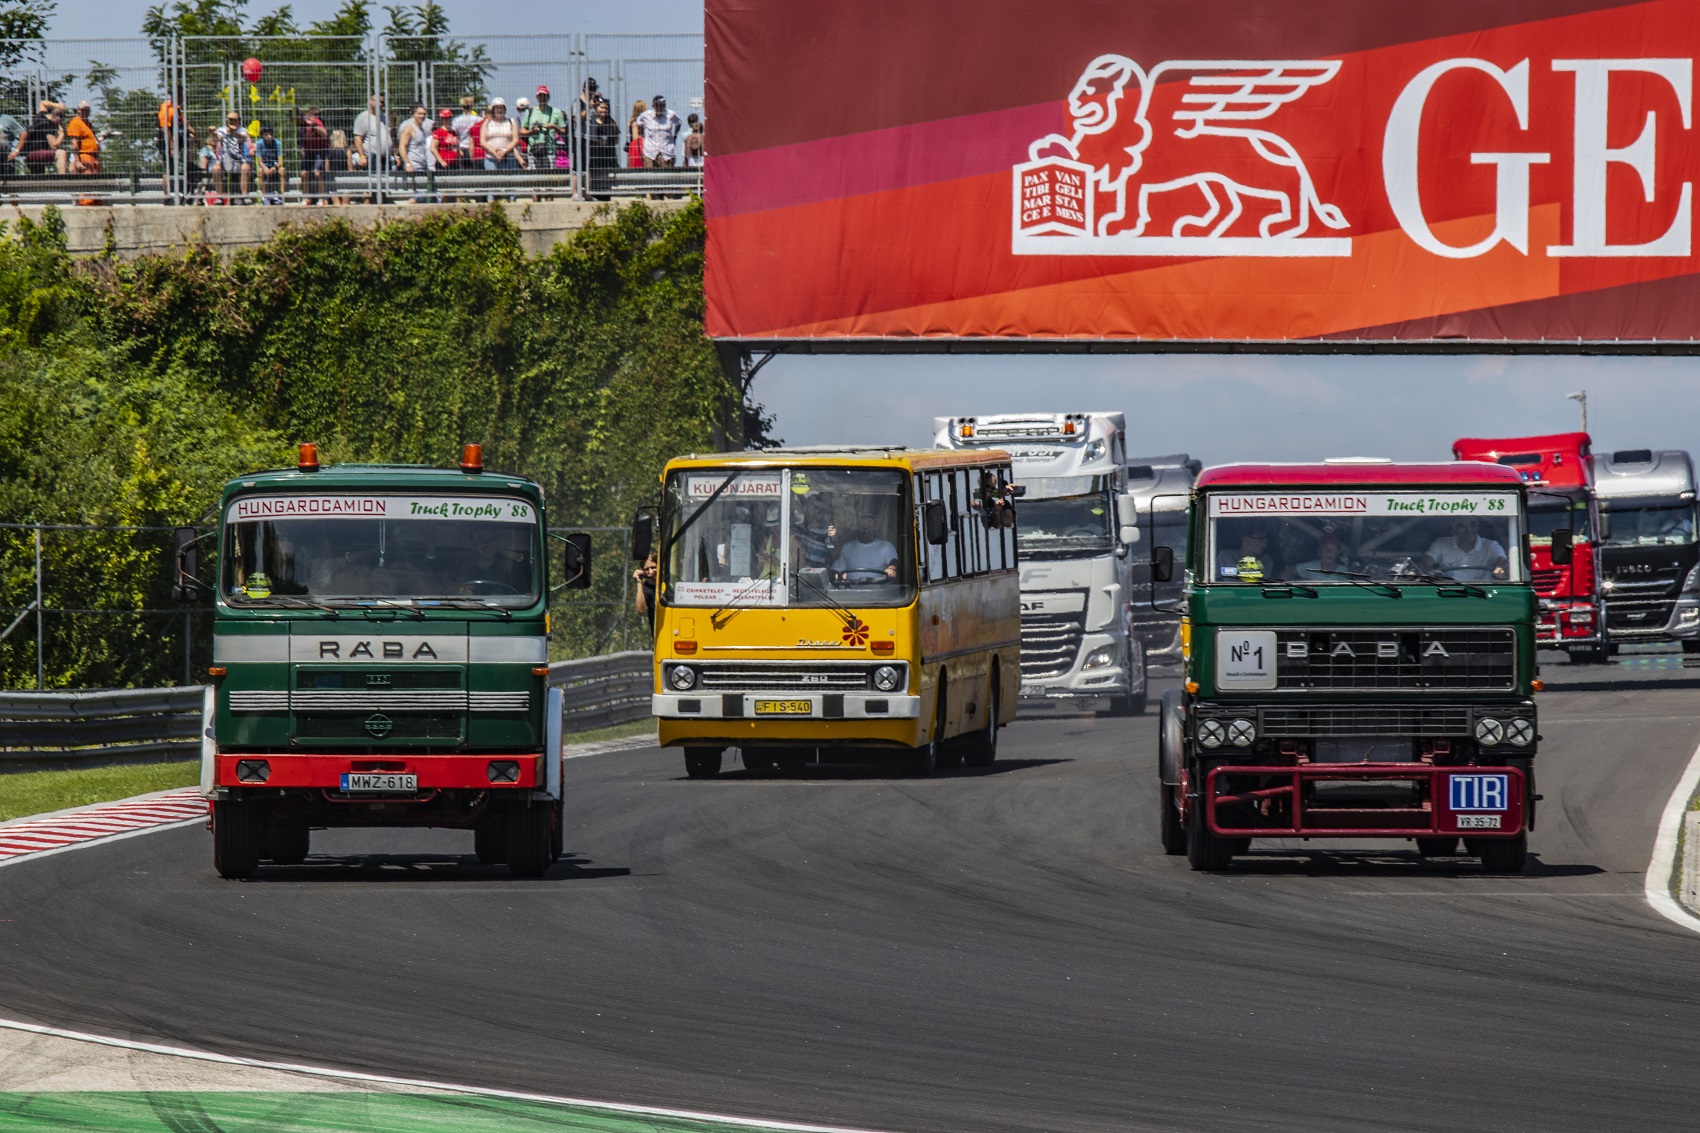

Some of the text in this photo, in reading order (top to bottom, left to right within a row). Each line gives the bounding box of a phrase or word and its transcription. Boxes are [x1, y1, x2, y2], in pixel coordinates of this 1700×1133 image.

[1382, 57, 1693, 259] GE
[1024, 170, 1049, 187] PAX
[1054, 170, 1080, 186] VAN
[1024, 183, 1050, 198] TIBI
[1055, 183, 1083, 199] GELI
[1023, 195, 1052, 210] MAR
[1055, 195, 1079, 210] STA
[1022, 206, 1051, 222] CE E
[238, 499, 386, 515] HUNGAROCAMION
[410, 502, 448, 518] Truck
[452, 502, 502, 518] Trophy
[1219, 497, 1367, 511] HUNGAROCAMION
[1387, 498, 1425, 513] Truck
[1428, 498, 1478, 513] Trophy
[319, 641, 438, 659] RÁBA
[1286, 641, 1450, 658] BABA
[1253, 646, 1263, 670] 1
[351, 776, 414, 789] MWZ-618
[1454, 777, 1502, 808] TIR
